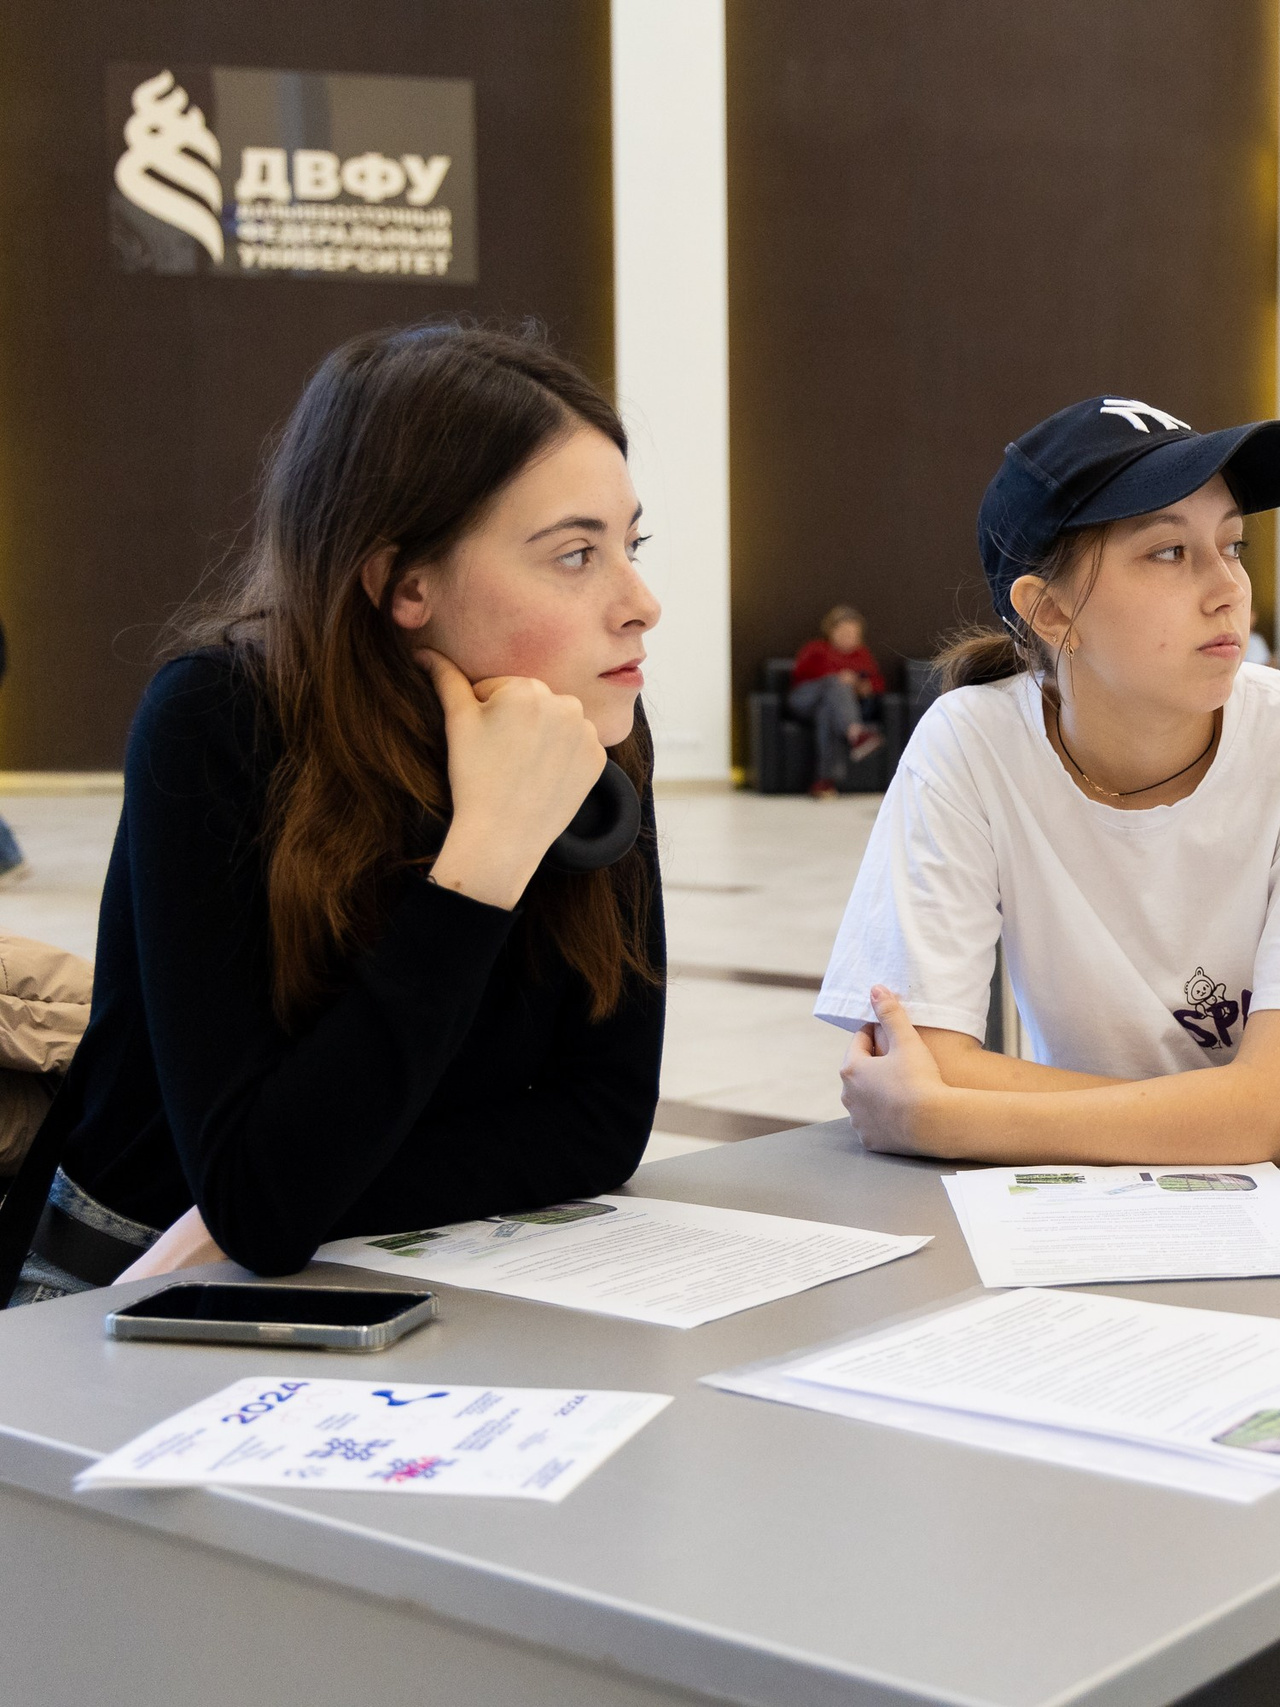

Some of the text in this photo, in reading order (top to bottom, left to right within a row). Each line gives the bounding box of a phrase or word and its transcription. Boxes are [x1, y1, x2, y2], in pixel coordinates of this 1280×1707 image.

[234, 146, 452, 206] ДВФУ
[235, 222, 453, 249] ФЕДЕРАЛЬНЫЙ
[237, 244, 453, 275] УНИВЕРСИТЕТ
[222, 1382, 310, 1424] 2024
